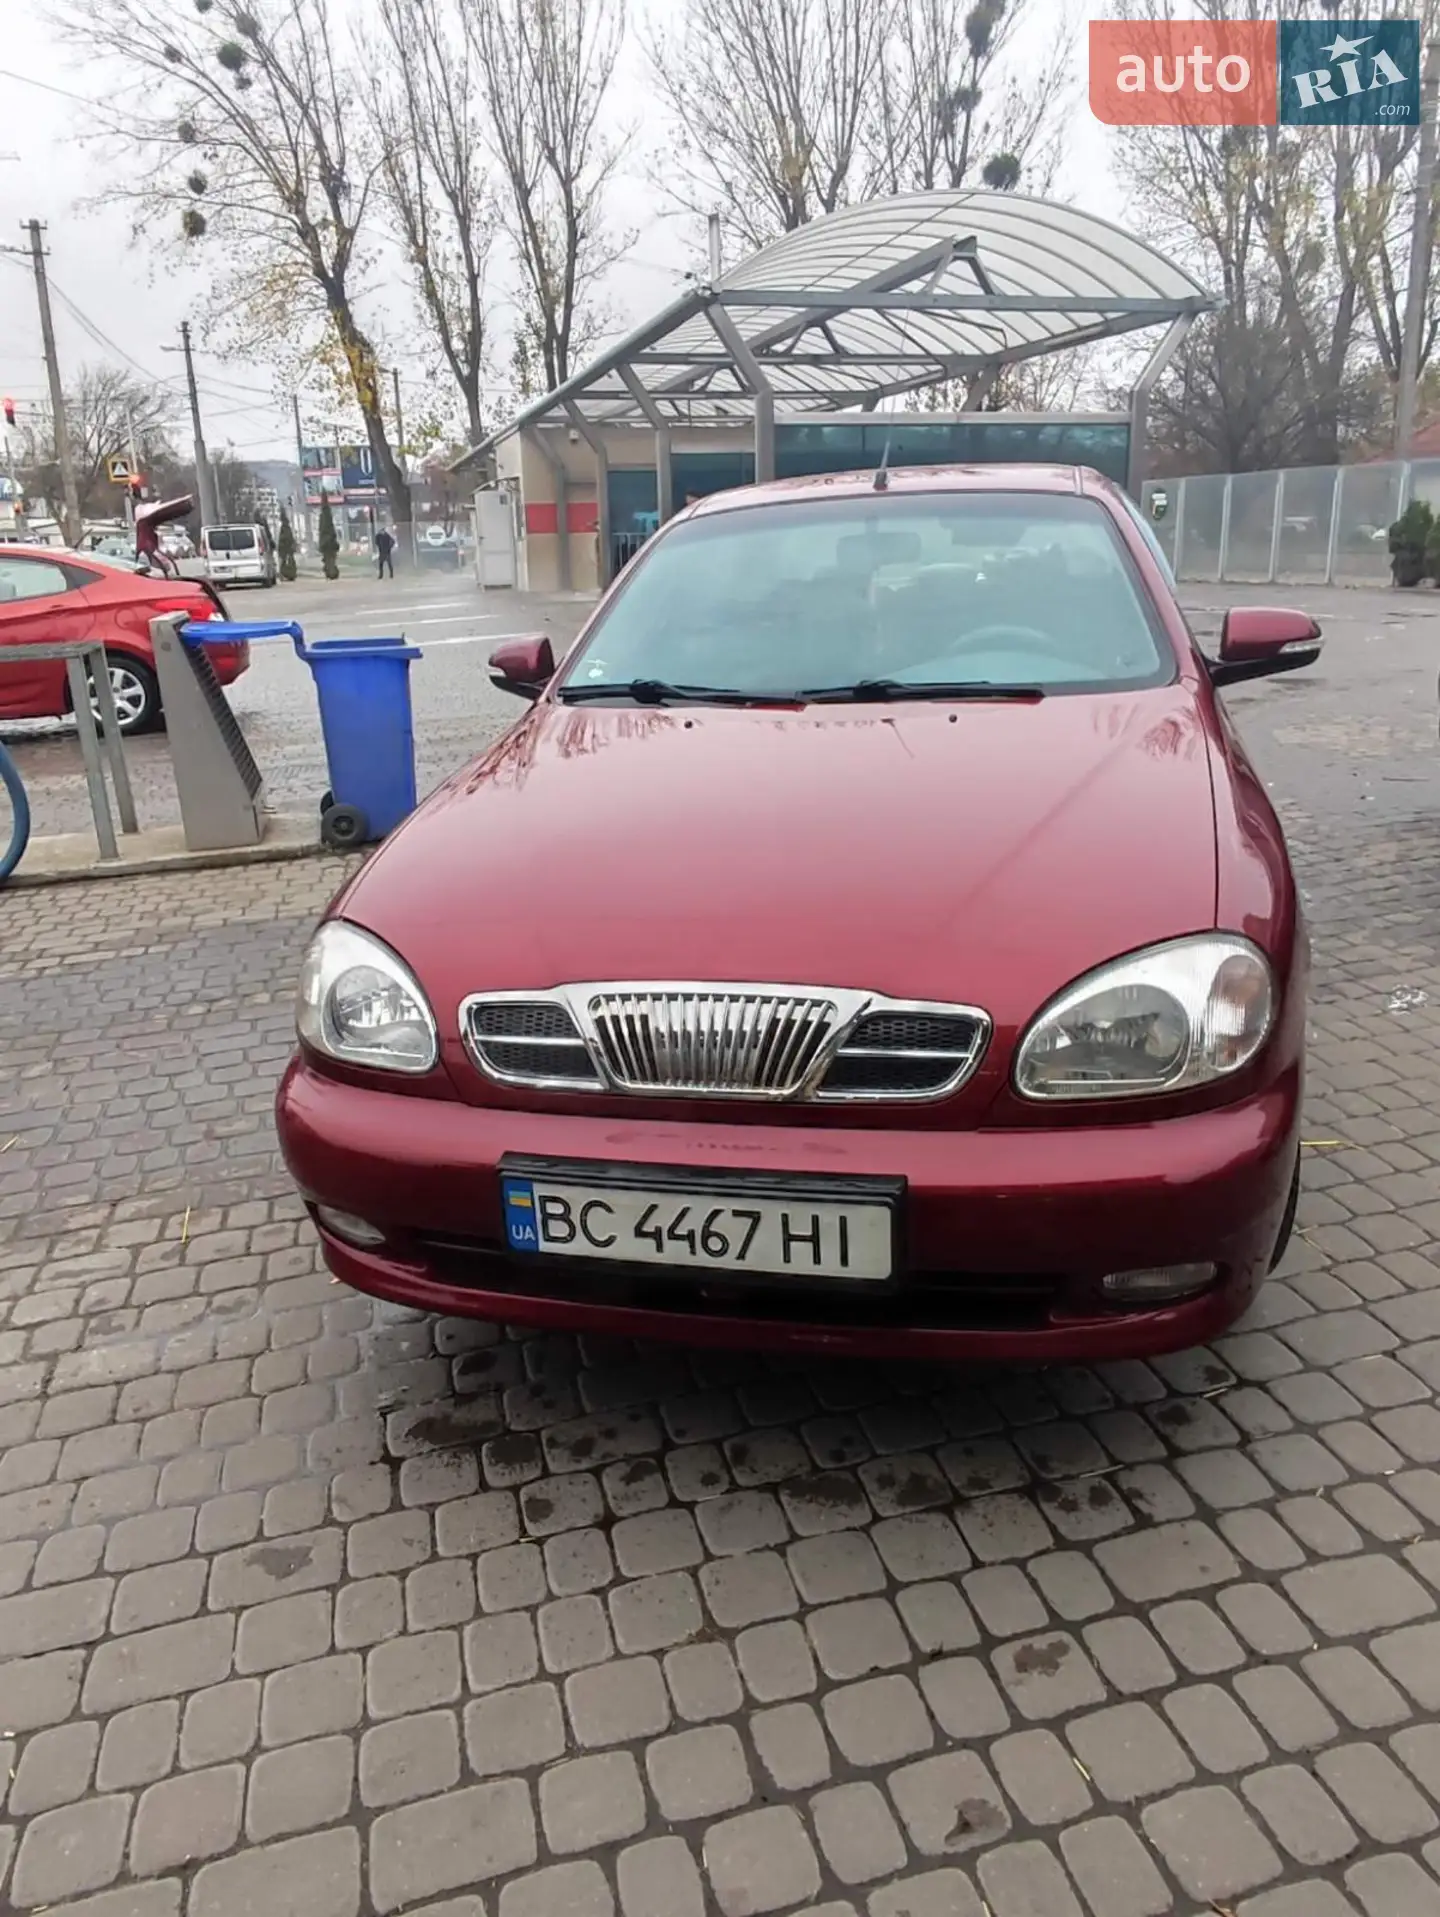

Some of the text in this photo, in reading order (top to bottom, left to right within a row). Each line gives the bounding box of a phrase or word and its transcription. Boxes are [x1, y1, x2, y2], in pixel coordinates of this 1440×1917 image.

[511, 1224, 535, 1242] UA
[539, 1195, 849, 1267] BC 4467 HI
